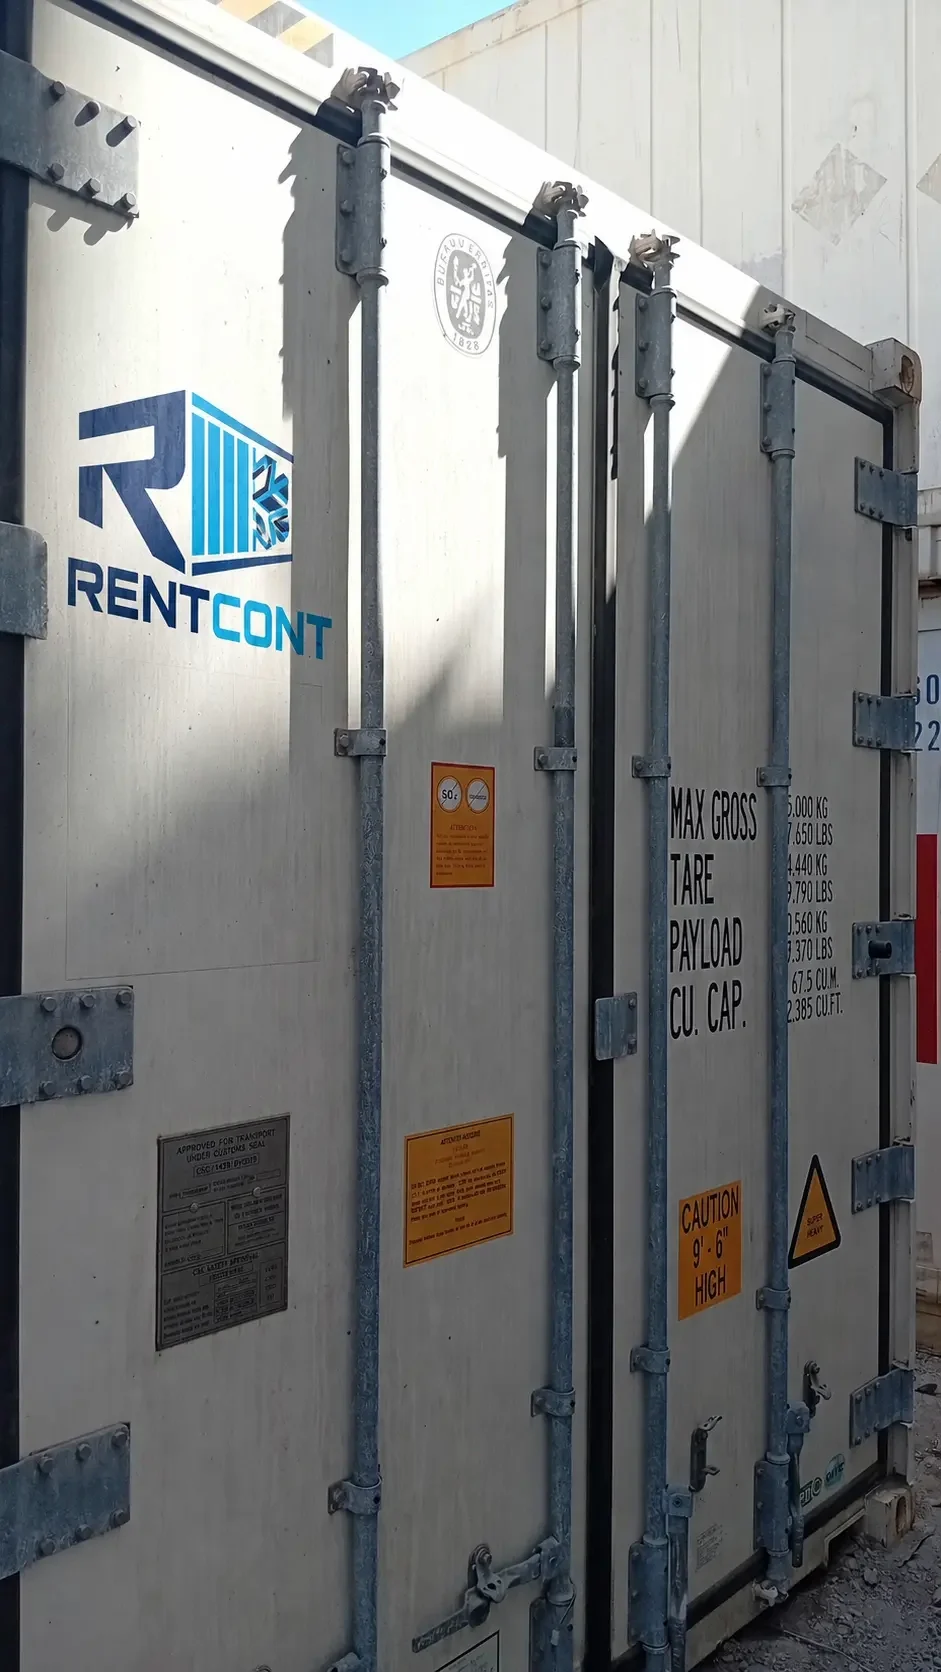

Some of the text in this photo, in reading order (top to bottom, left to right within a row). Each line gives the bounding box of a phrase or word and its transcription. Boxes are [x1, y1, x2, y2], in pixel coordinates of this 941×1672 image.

[453, 332, 479, 351] 1828
[67, 556, 332, 660] RENTCONT
[916, 674, 940, 705] 0
[671, 786, 757, 841] MAX GROSS
[816, 796, 828, 819] KG
[816, 823, 833, 846] LBS
[816, 853, 828, 876] KG
[670, 854, 714, 905] TARE
[816, 880, 833, 903] LBS
[816, 910, 828, 934] KG
[669, 917, 742, 973] PAYLOAD
[816, 936, 833, 960] LBS
[791, 966, 840, 994] 67.5 CU.M.
[670, 979, 746, 1039] CU. CAP.
[815, 992, 843, 1017] CU.FT.
[176, 1128, 276, 1155] APPROVED FOR TRANSPORT
[186, 1140, 266, 1163] UNDER CUSTOMS SEAL
[682, 1185, 739, 1234] CAUTION
[806, 1212, 823, 1227] SUPER
[806, 1225, 824, 1240] HEAVY
[693, 1235, 704, 1268] 9'
[716, 1226, 728, 1259] 6"
[695, 1264, 726, 1307] HIGH
